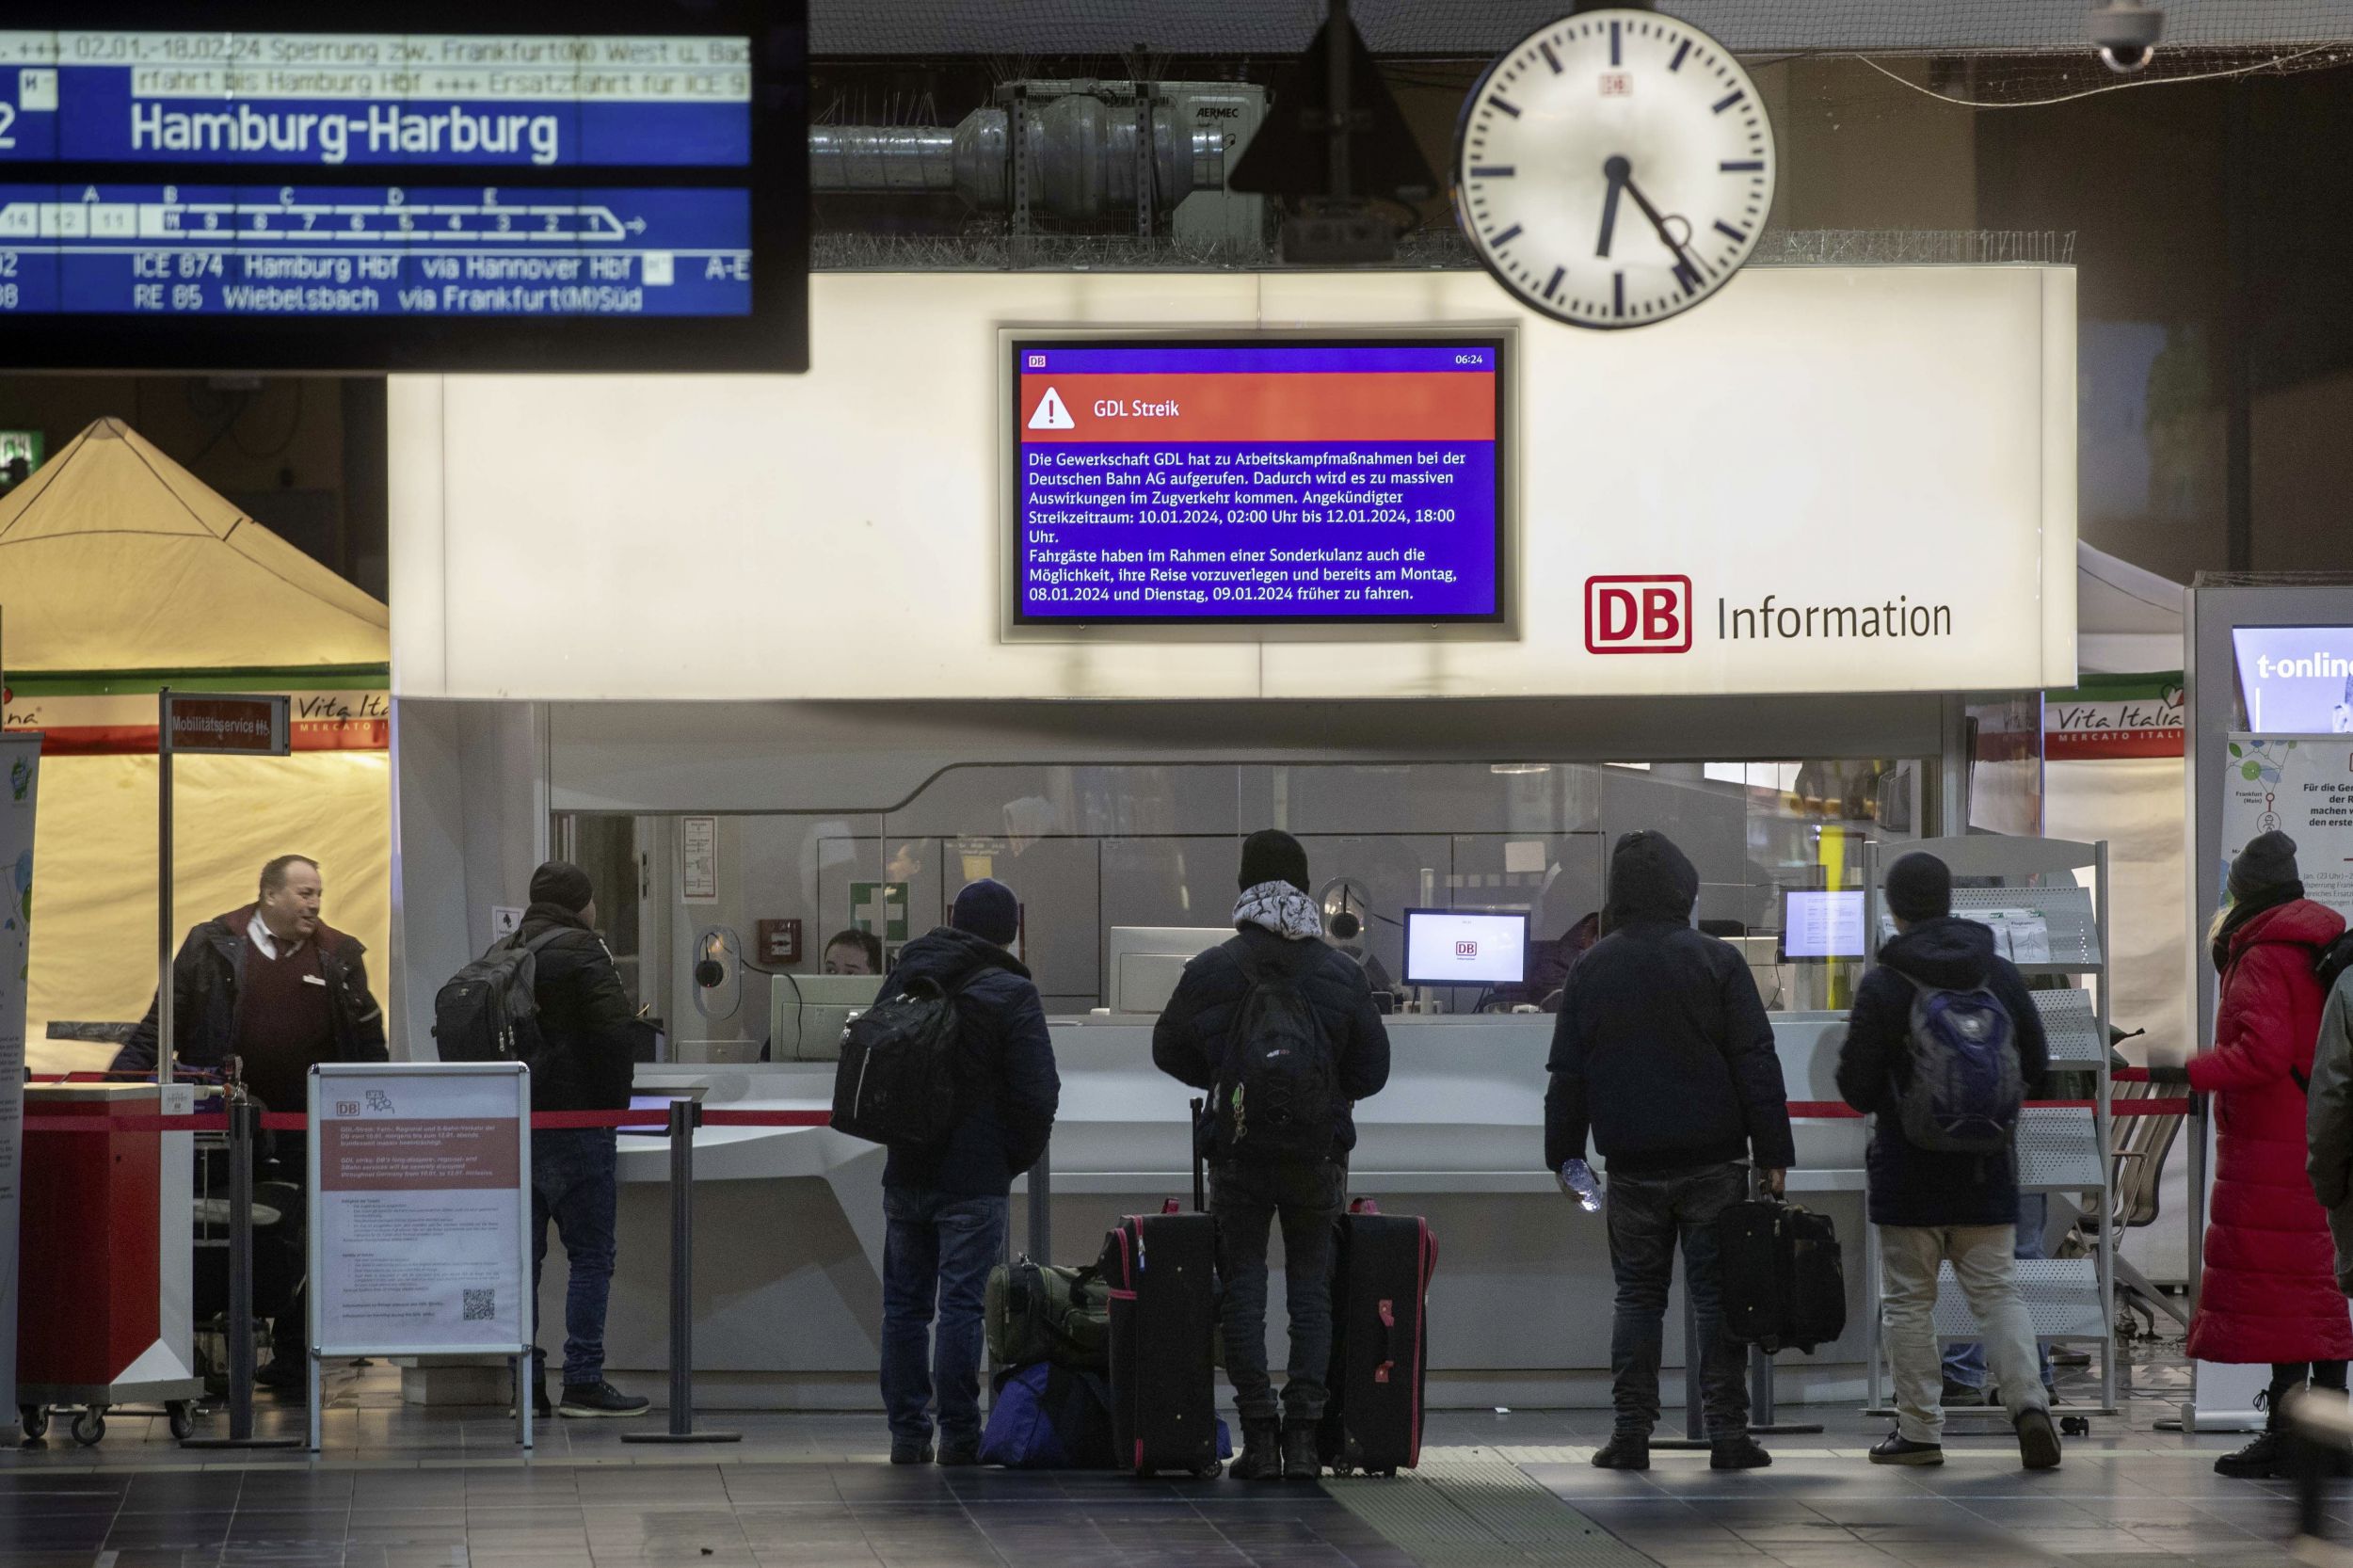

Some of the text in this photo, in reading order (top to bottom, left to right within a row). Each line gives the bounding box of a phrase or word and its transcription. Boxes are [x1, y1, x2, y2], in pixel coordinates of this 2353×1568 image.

[270, 39, 378, 65] Sperrung
[388, 43, 433, 61] zw.
[608, 42, 667, 62] West
[267, 72, 372, 97] Hamburg
[380, 72, 422, 92] Hbf
[488, 72, 631, 93] Ersatzfahrt
[1196, 107, 1239, 120] AERMEC
[132, 104, 557, 165] Hamburg-Harburg
[82, 185, 100, 203] A
[163, 185, 178, 203] B
[280, 186, 295, 204] C
[388, 187, 405, 205] D
[303, 214, 320, 232] 7
[447, 215, 462, 232] 4
[496, 215, 511, 233] 3
[545, 216, 559, 233] 2
[587, 216, 600, 232] 1
[0, 251, 18, 278] 2
[133, 254, 171, 279] ICE
[244, 255, 351, 283] Hamburg
[358, 255, 401, 280] Hbf
[422, 257, 459, 280] via
[466, 256, 582, 280] Hannover
[590, 256, 632, 280] Hbf
[133, 284, 164, 310] RE
[222, 285, 378, 311] Wiebelsbach
[398, 287, 437, 312] via
[1030, 355, 1482, 367] DB 06:24
[1094, 399, 1179, 417] GDL Streik
[1029, 451, 1465, 468] Die Gewerkschaft GDL hat zu Arbeitskampfmaßnahmen bei der
[1029, 471, 1453, 488] Deutschen Bahn AG aufgerufen. Dadurch wird es zu massiven
[1029, 490, 1403, 507] Auswirkungen im Zugverkehr kommen. Angekündigter
[1029, 509, 1455, 525] Streikzeitraum: 10.01.2024, 02:00 Uhr bis 12.01.2024, 18:00
[1029, 530, 1059, 543] Uhr.
[1030, 548, 1425, 566] Fahrgäste haben im Rahmen einer Sonderkulanz auch die
[1030, 567, 1457, 584] Möglichkeit, ihre Reise vorzuverlegen und bereits am Montag,
[1029, 586, 1414, 603] 08.01.2024 und Dienstag, 09.01.2024 früher zu fahren.
[1596, 584, 1952, 645] DB Information
[298, 695, 352, 719] Vita
[4, 712, 39, 725] na
[172, 715, 254, 733] Mobilitätsservice
[2058, 705, 2184, 729] Vita Italia
[300, 721, 372, 731] MERCATO
[2058, 729, 2182, 743] MERCATO ITALI
[2303, 783, 2318, 792] Für
[2321, 782, 2336, 792] die
[2310, 806, 2347, 815] machen
[2309, 818, 2327, 826] den
[1458, 943, 1475, 954] DB
[339, 1103, 359, 1115] DB
